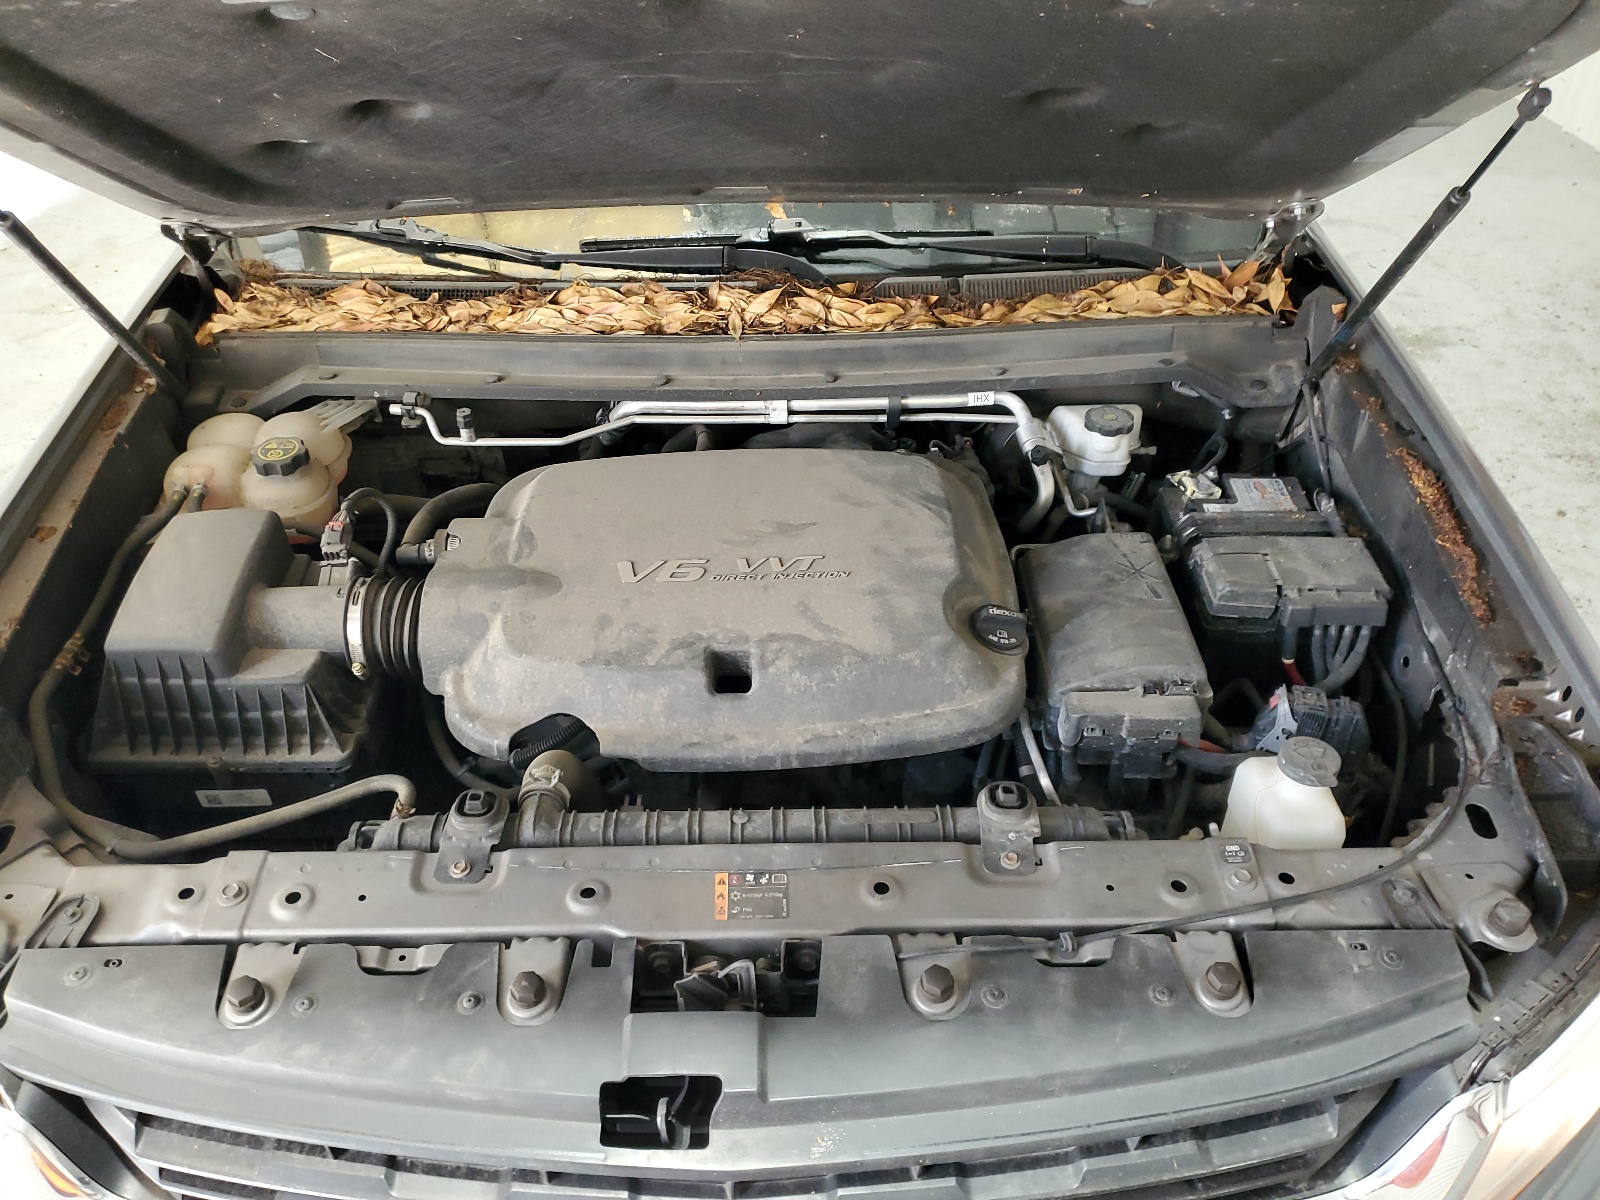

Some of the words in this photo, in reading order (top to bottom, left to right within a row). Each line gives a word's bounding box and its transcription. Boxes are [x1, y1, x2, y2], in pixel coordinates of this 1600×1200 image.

[973, 393, 990, 403] IHX
[617, 559, 710, 583] V6
[736, 555, 825, 573] VVT
[773, 571, 851, 580] INJECTION
